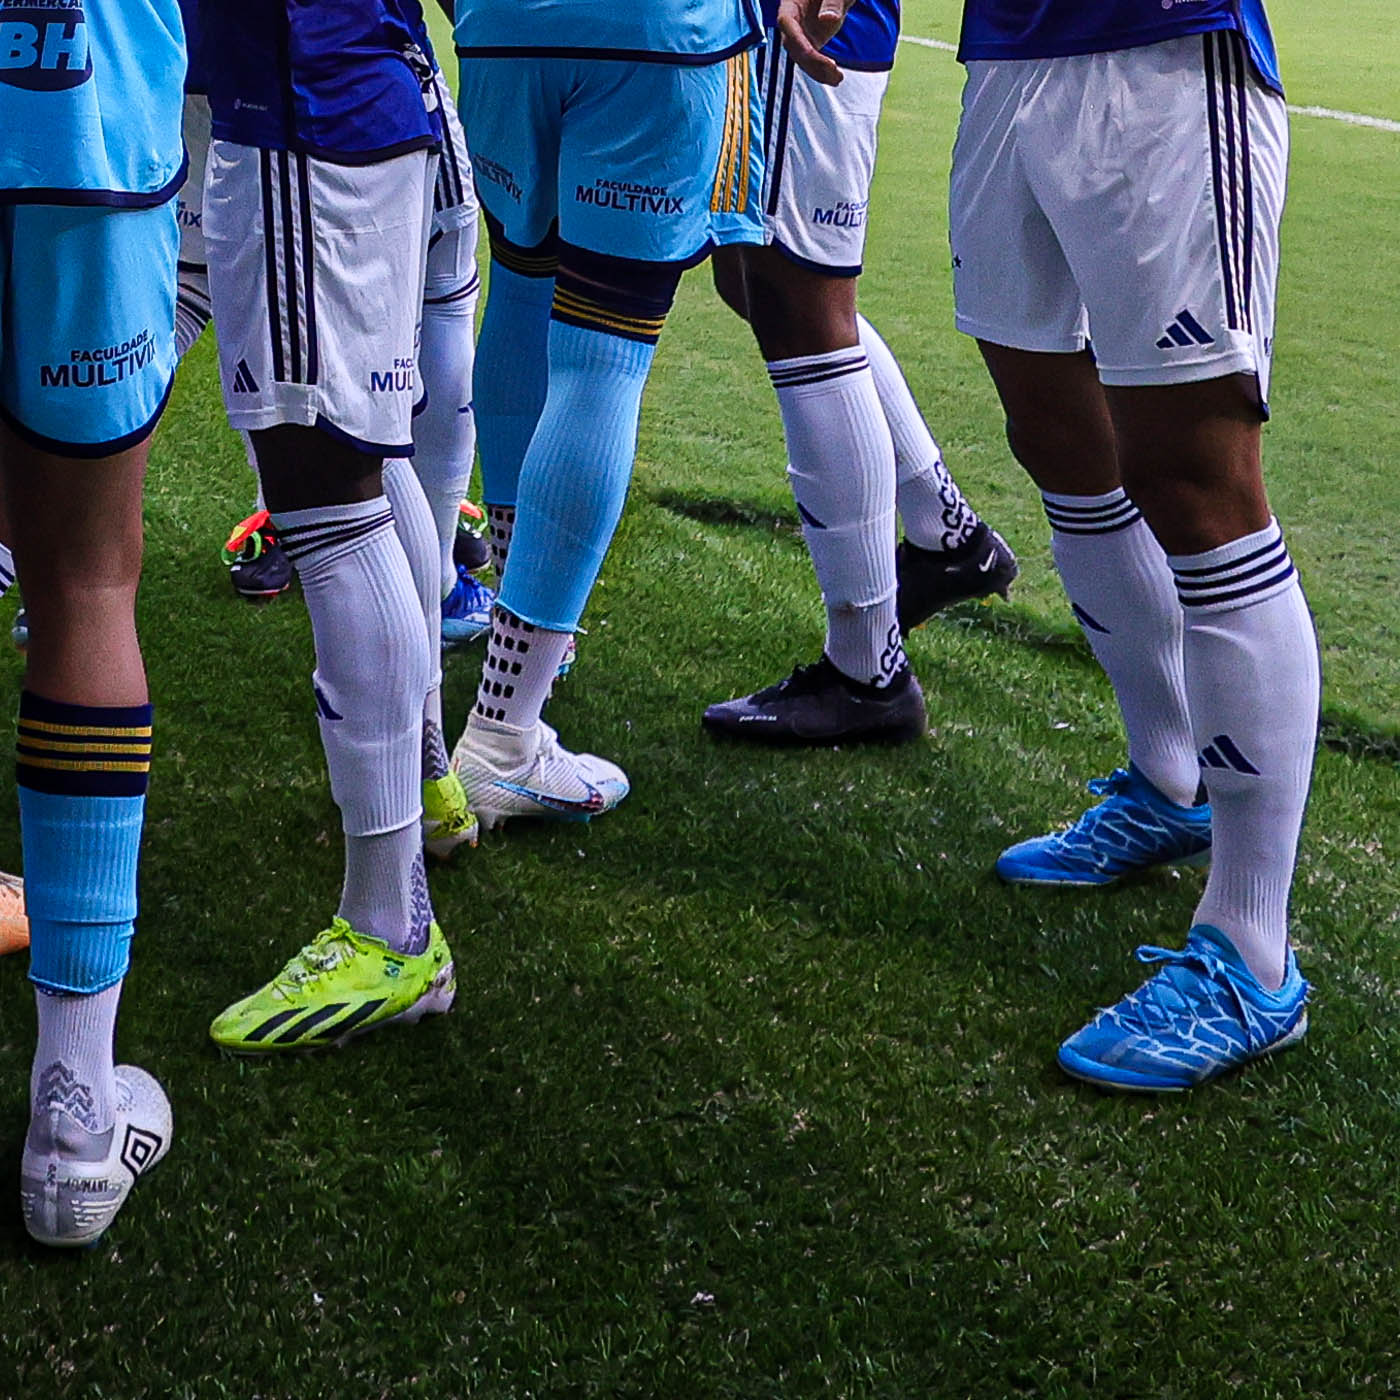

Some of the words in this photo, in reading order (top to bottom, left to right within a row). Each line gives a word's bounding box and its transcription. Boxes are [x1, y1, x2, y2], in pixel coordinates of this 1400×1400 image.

[576, 185, 684, 214] MULTIVIX
[596, 178, 668, 196] FACULDADE
[39, 334, 156, 387] MULTIVIX
[70, 329, 149, 362] FACULDADE
